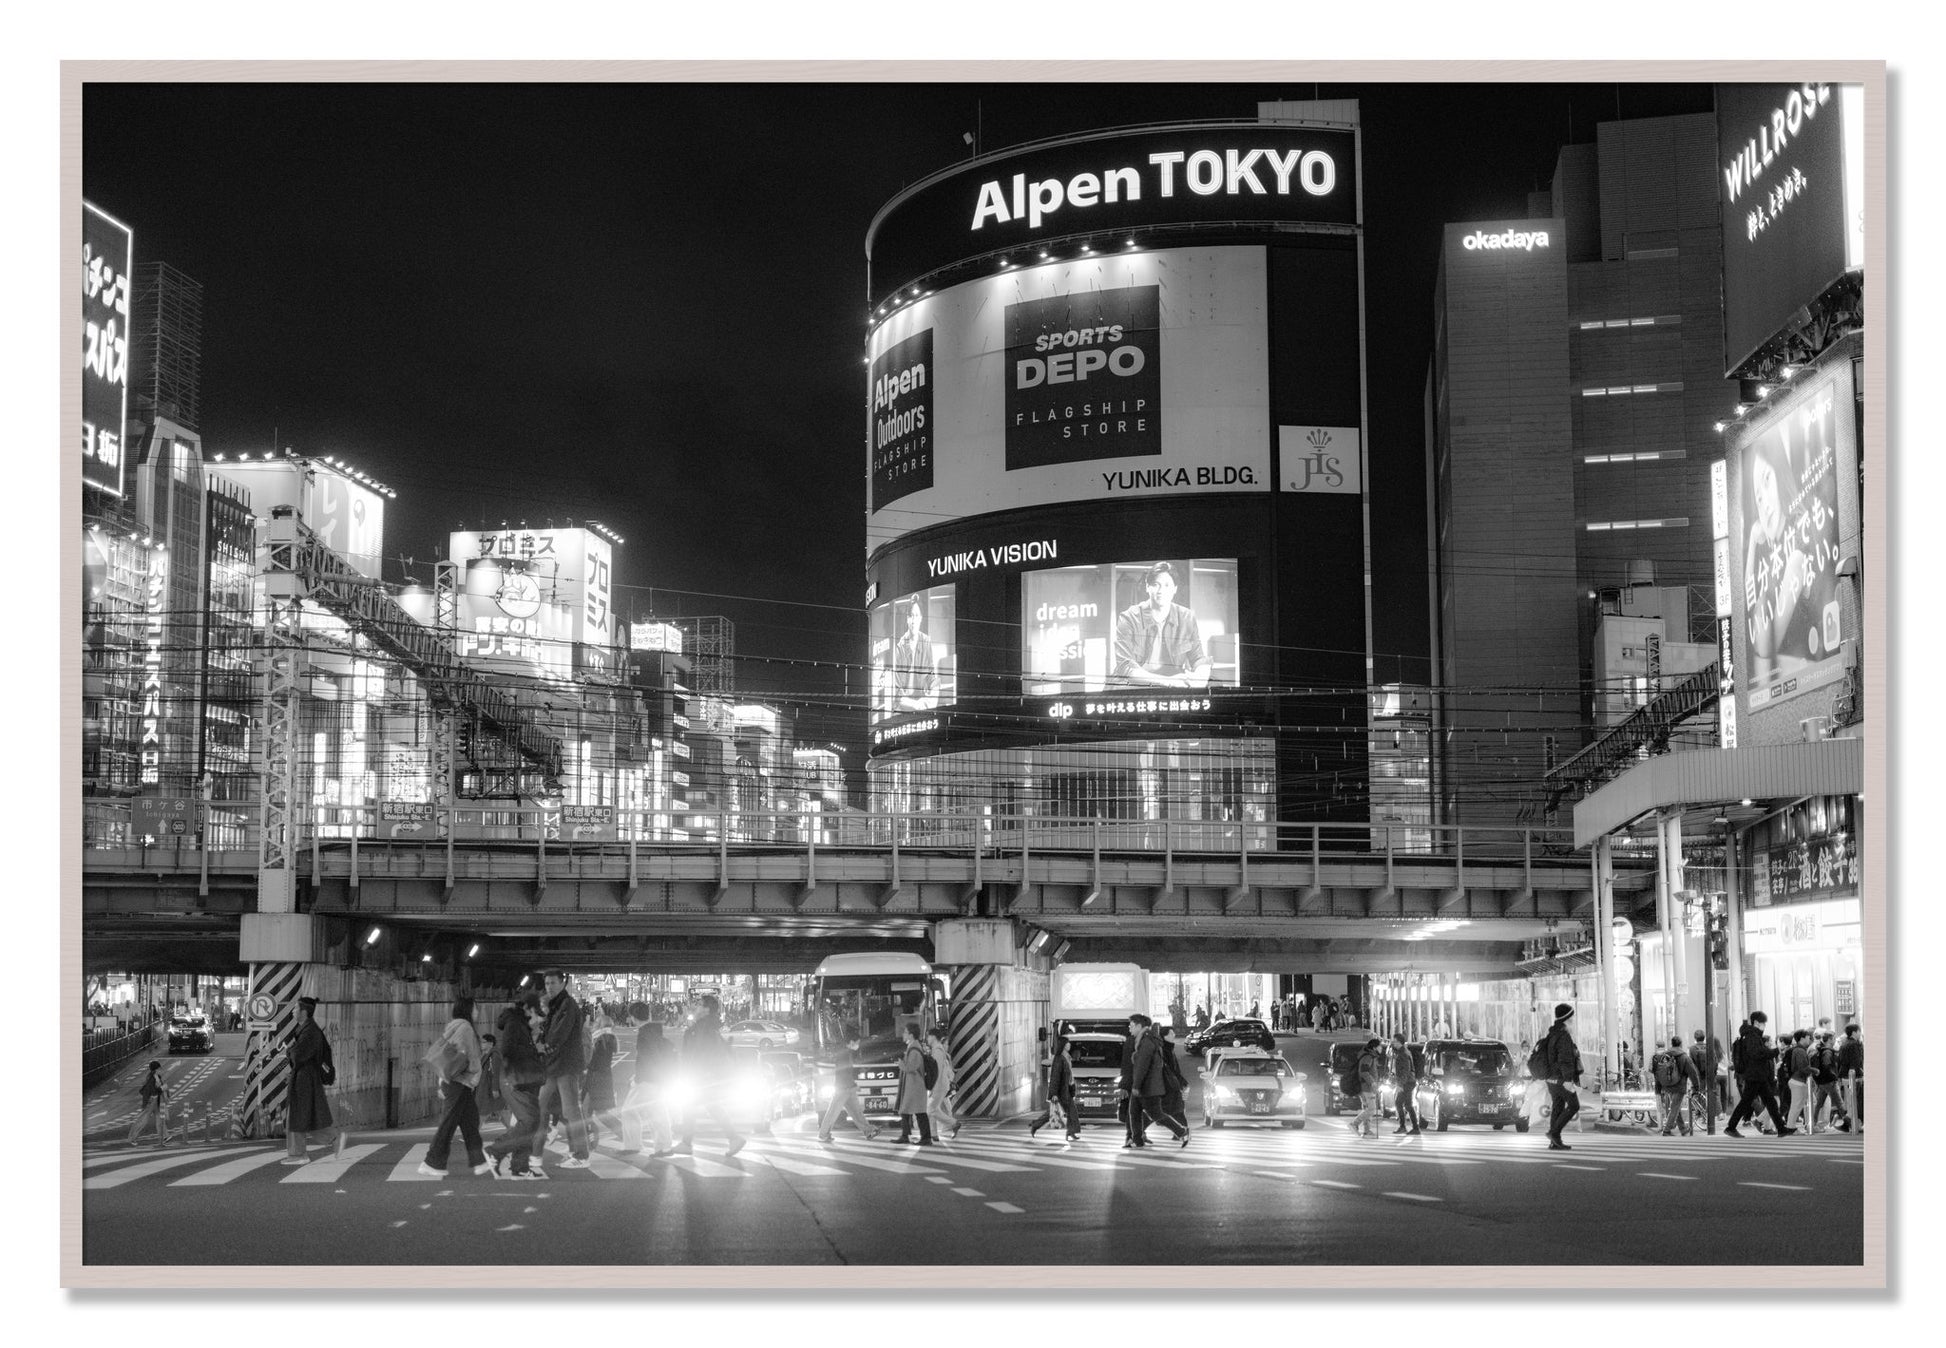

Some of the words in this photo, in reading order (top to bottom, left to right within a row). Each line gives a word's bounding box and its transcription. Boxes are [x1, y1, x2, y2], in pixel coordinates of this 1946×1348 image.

[970, 166, 1142, 231] Alpen
[1148, 148, 1337, 198] TOKYO
[1462, 229, 1550, 252] okadaya
[1034, 323, 1124, 354] SPORTS
[1016, 345, 1146, 391] DEPO
[873, 361, 926, 414] Alpen
[876, 402, 926, 450] Outdoors
[1016, 398, 1148, 426] FLAGSHIP
[1063, 418, 1148, 440] STORE
[873, 435, 928, 473] FLAGSHIP
[887, 455, 928, 482] STORE
[1102, 466, 1190, 492] YUNIKA
[1197, 465, 1259, 486] BLDG.
[217, 540, 249, 564] SHISHA
[478, 534, 556, 557] プロミス
[928, 550, 987, 578] YUNIKA
[990, 538, 1058, 565] VISION
[1745, 496, 1835, 612] 自分本位でも、
[1748, 538, 1839, 645] いいじゃない。
[1036, 602, 1099, 621] dream
[1048, 702, 1073, 719] dip
